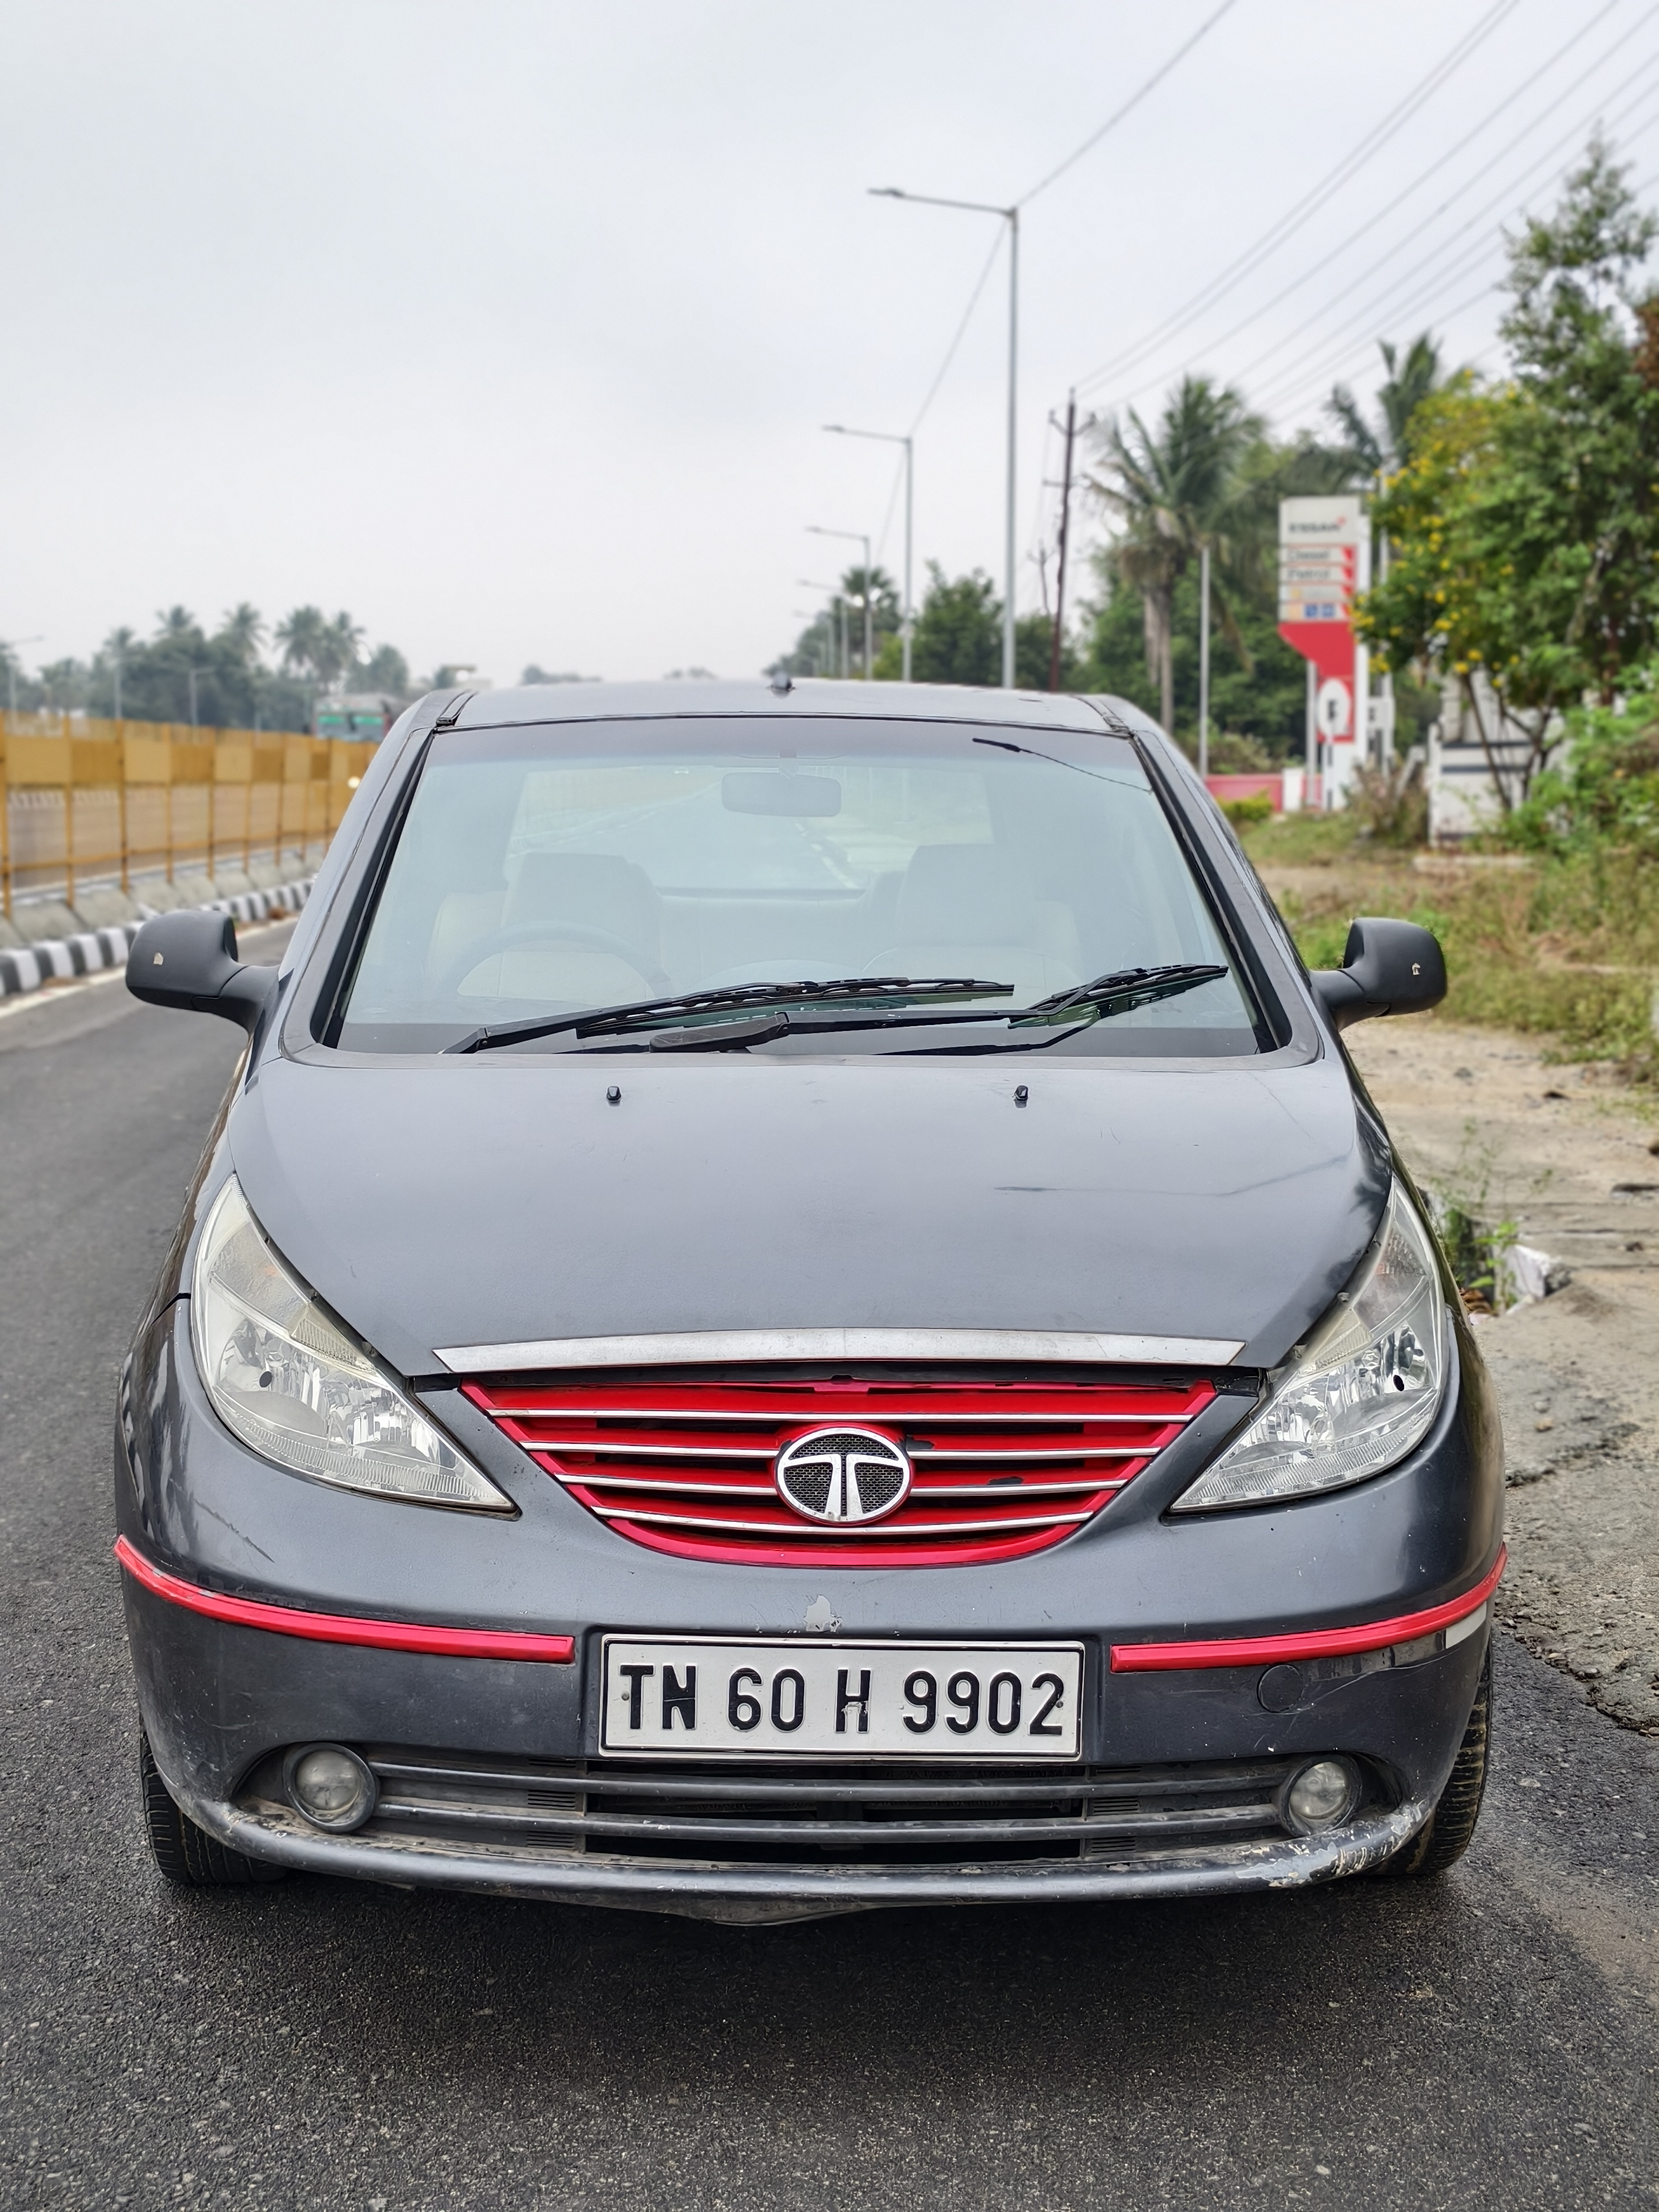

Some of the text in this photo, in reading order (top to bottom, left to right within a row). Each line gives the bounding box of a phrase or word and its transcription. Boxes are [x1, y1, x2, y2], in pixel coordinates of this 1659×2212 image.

[619, 1663, 1066, 1736] TN 60 H 9902
